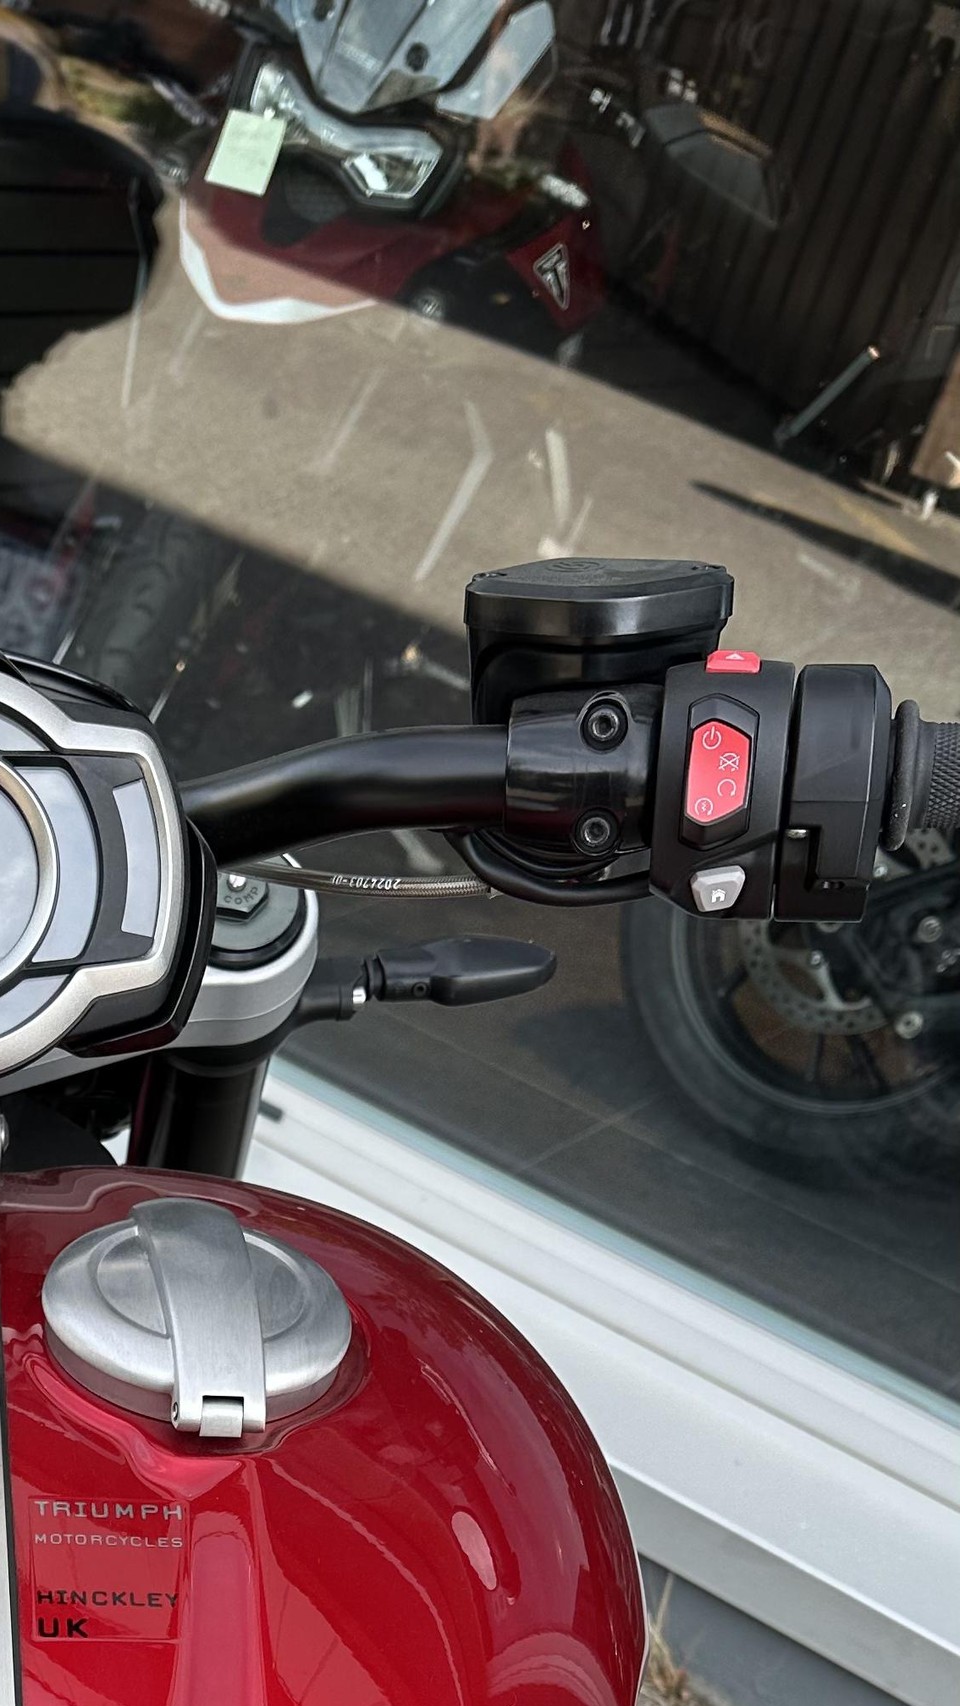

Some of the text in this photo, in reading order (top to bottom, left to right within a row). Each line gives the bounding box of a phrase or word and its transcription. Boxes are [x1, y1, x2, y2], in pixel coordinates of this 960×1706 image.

[331, 875, 402, 890] 2024703-01
[223, 886, 259, 905] COMP
[34, 1501, 183, 1521] TRIUMPH
[34, 1533, 183, 1548] MOTORCYCLES
[36, 1590, 179, 1608] HINCKLEY
[38, 1617, 89, 1638] UK
